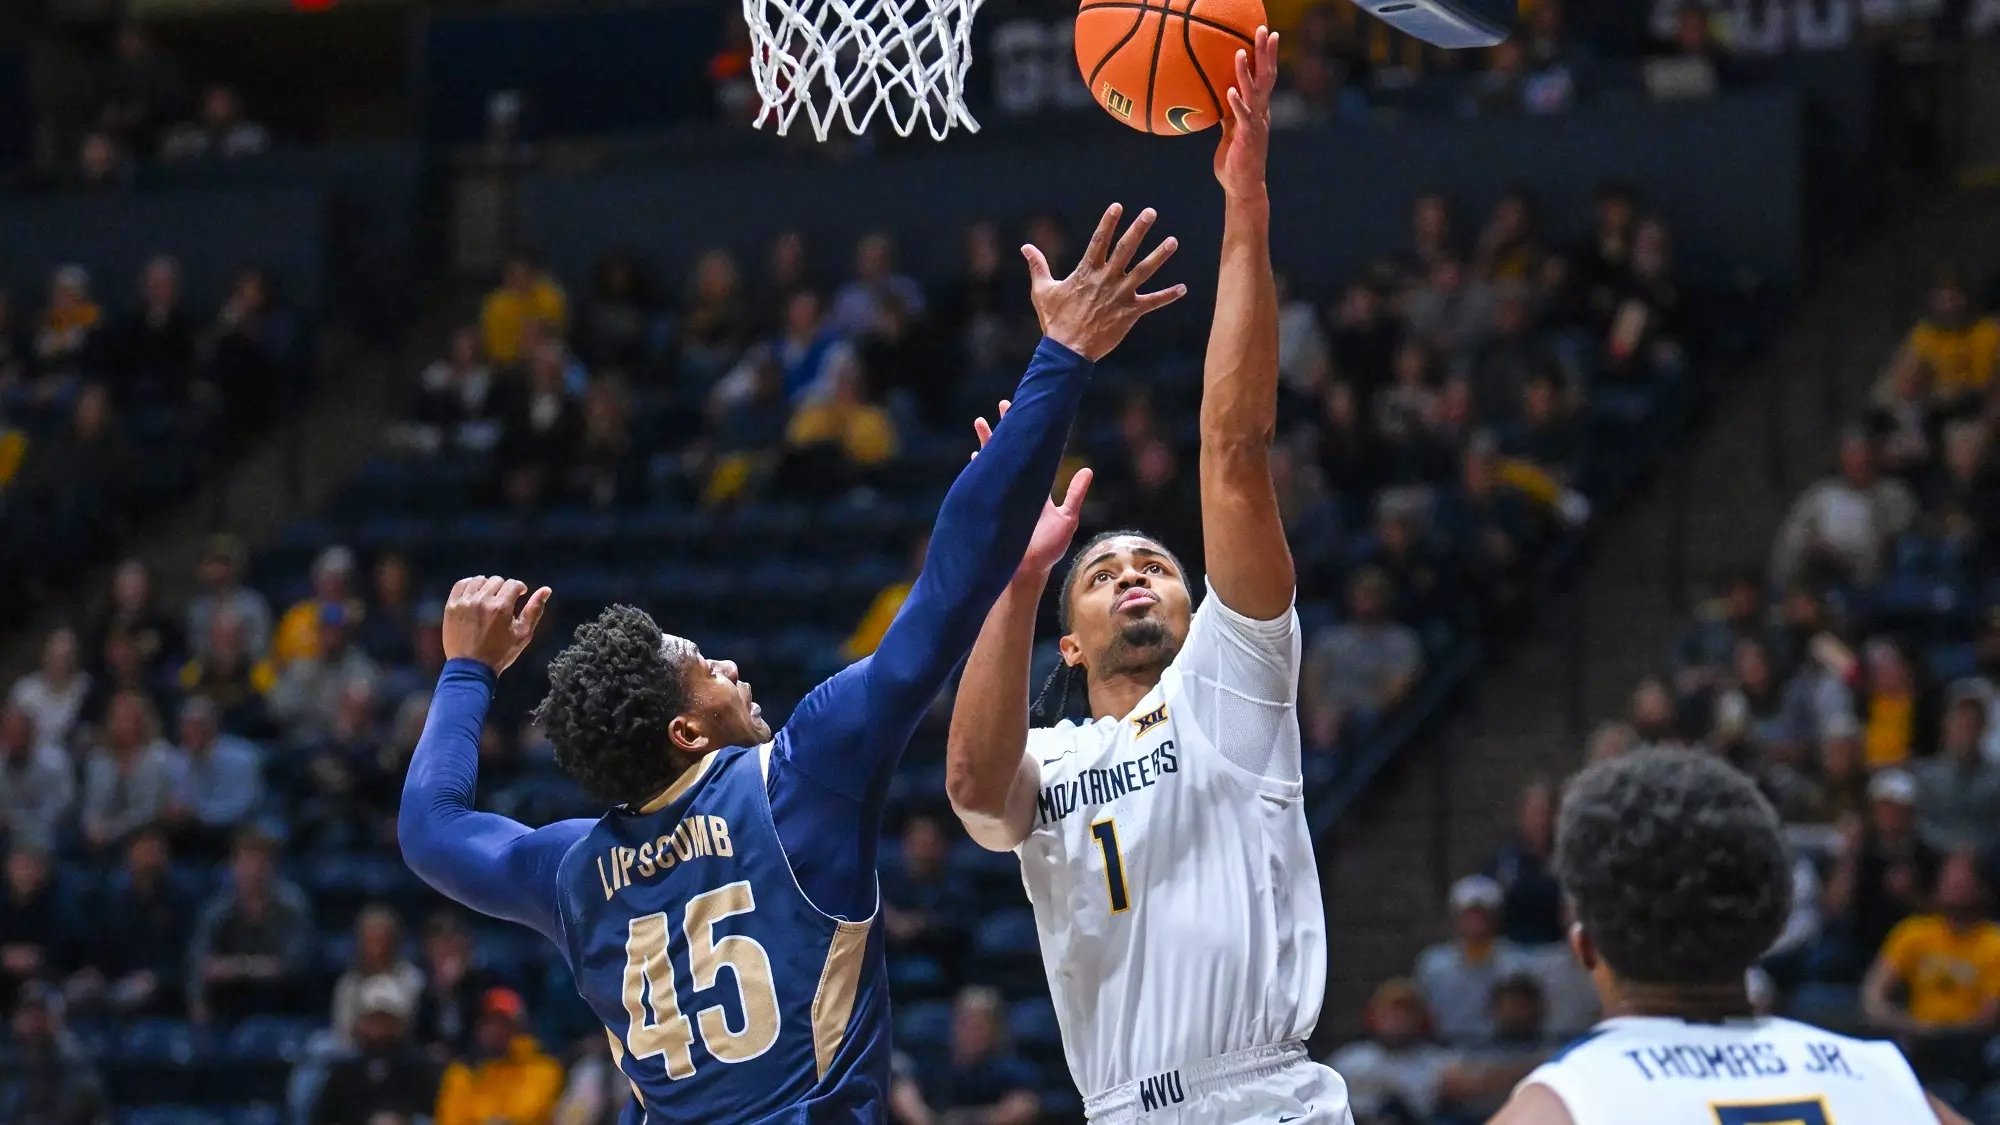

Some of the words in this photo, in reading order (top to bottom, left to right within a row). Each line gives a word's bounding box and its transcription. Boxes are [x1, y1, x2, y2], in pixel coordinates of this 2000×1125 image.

[1133, 703, 1168, 738] XII
[1038, 740, 1178, 824] MOUTAINEERS
[597, 815, 733, 900] LIPSCOMB
[1089, 817, 1131, 915] 1
[622, 880, 781, 1081] 45
[1140, 1069, 1185, 1112] WVU
[1625, 1042, 1788, 1081] THOMAS
[1804, 1041, 1864, 1081] JR.
